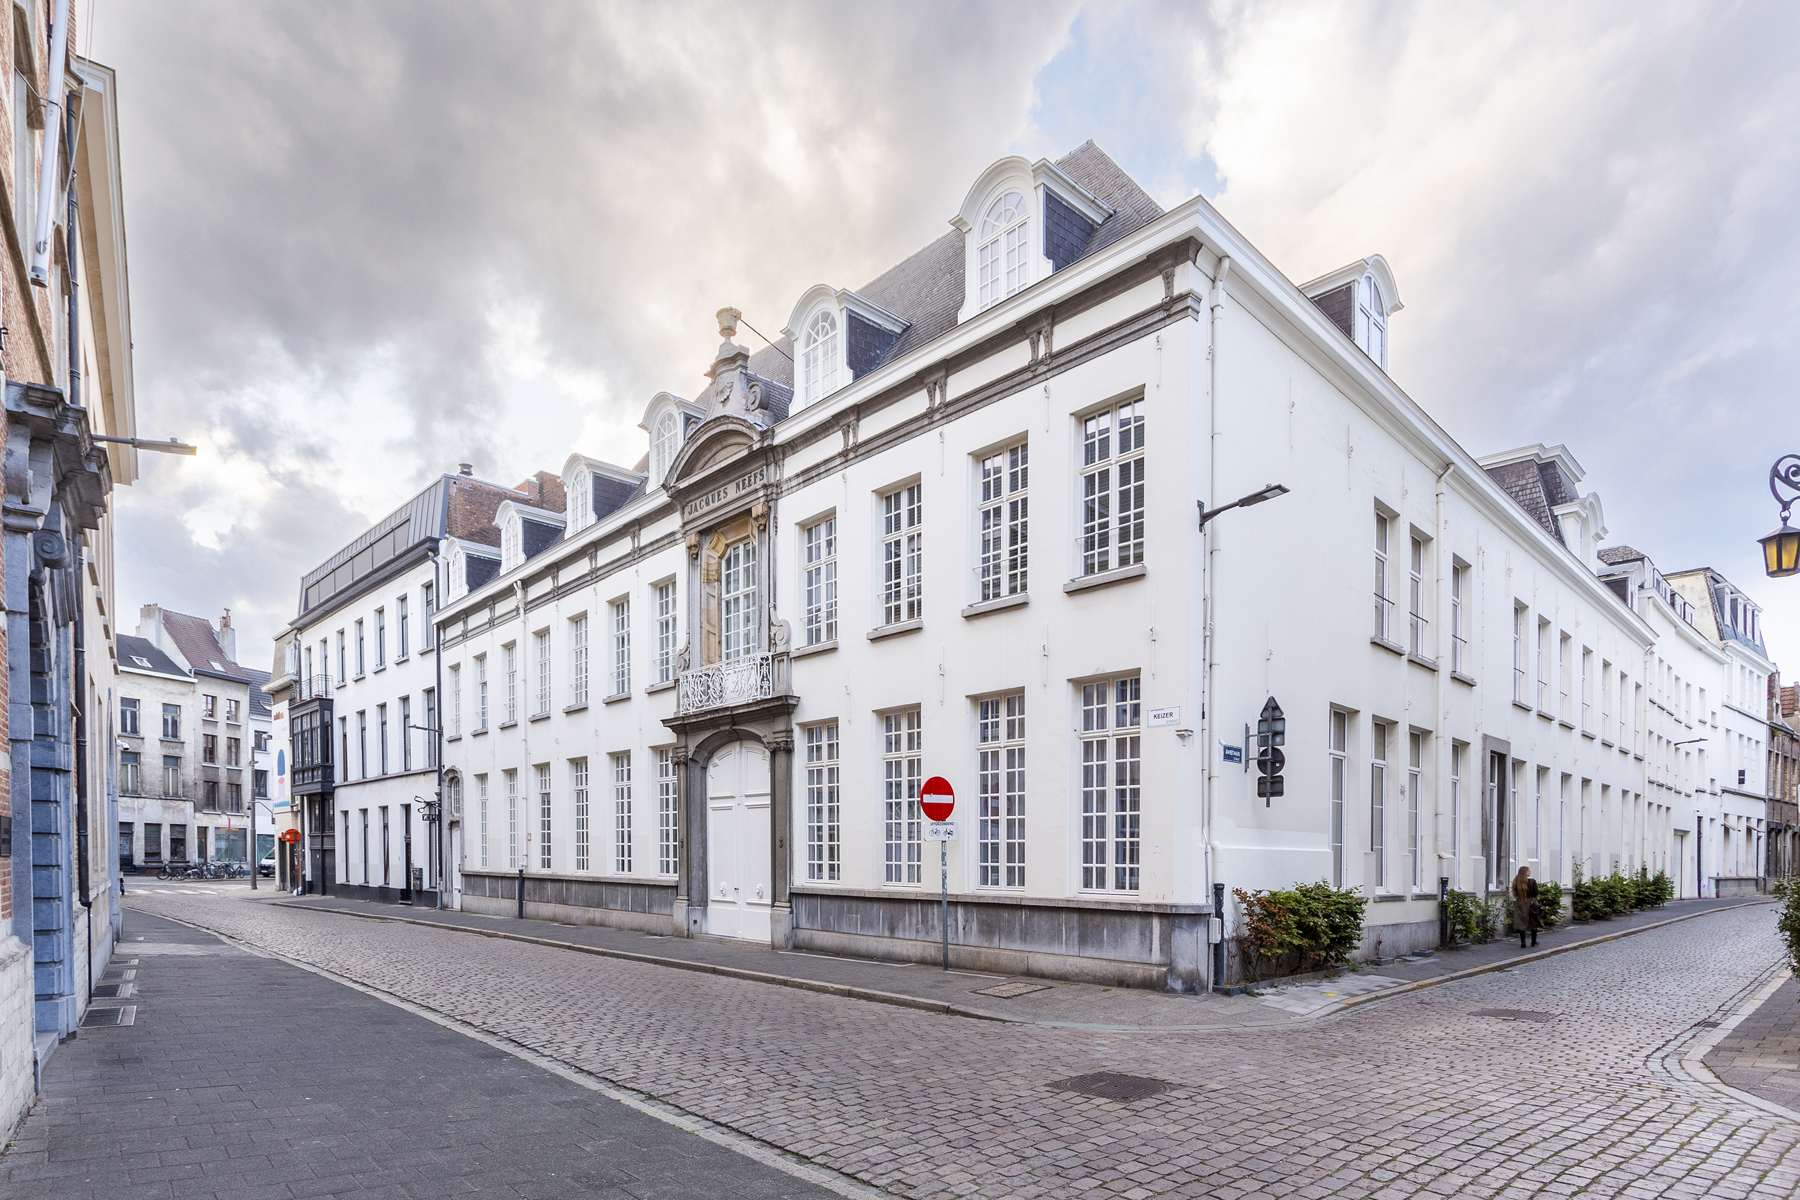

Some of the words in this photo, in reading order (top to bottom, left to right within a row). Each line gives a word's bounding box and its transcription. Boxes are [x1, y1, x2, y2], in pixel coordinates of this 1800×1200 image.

[688, 487, 728, 515] JACQUES
[735, 469, 764, 494] NEEFS
[1153, 711, 1174, 719] KEIZER
